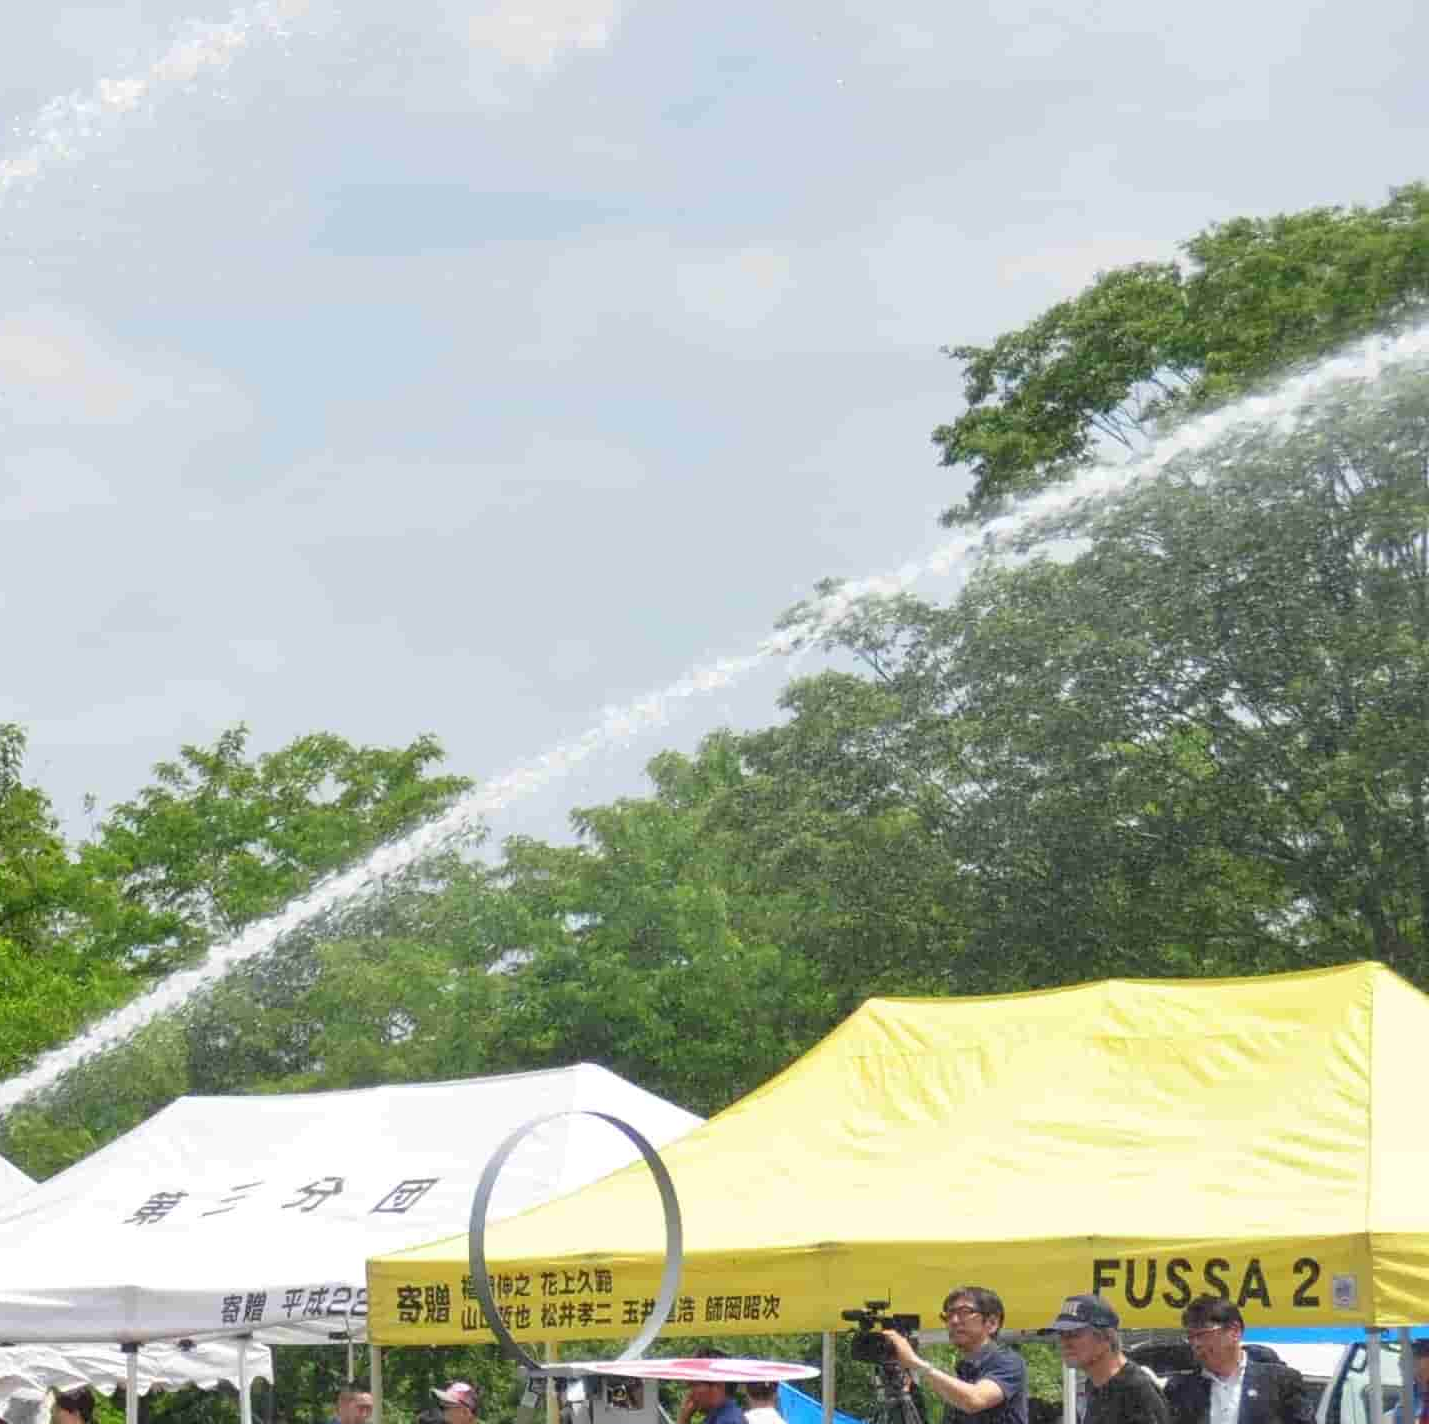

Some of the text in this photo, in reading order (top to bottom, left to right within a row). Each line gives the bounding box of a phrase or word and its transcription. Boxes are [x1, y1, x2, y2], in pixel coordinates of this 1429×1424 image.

[123, 1177, 441, 1225] 第三分団
[396, 1284, 452, 1324] 寄贈
[1092, 1257, 1321, 1309] FUSSA 2
